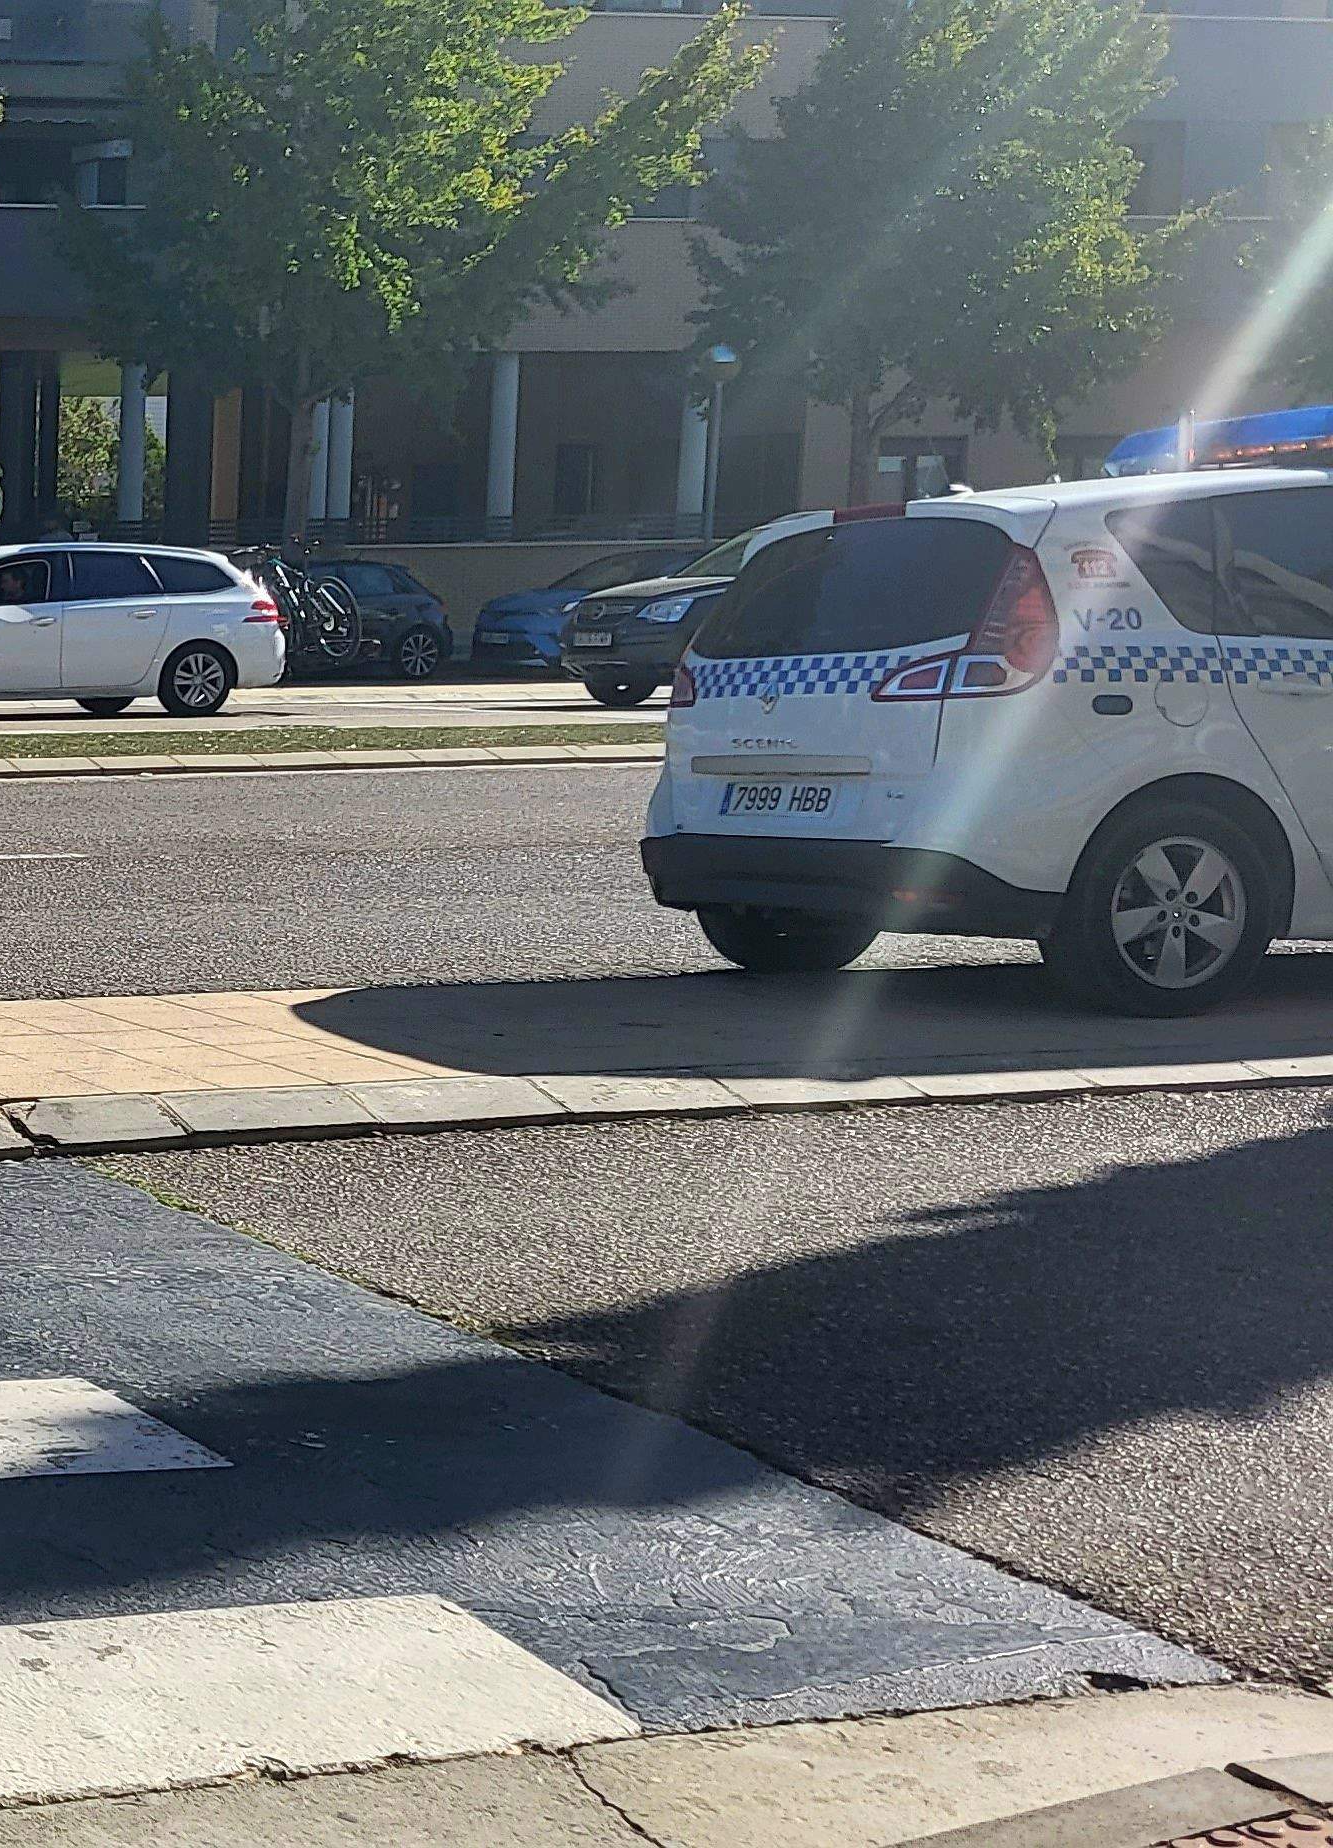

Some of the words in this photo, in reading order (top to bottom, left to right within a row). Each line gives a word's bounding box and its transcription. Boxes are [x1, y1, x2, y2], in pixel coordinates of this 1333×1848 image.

[1072, 607, 1142, 632] V-20
[733, 786, 782, 811] 7999
[788, 786, 832, 813] HBB
